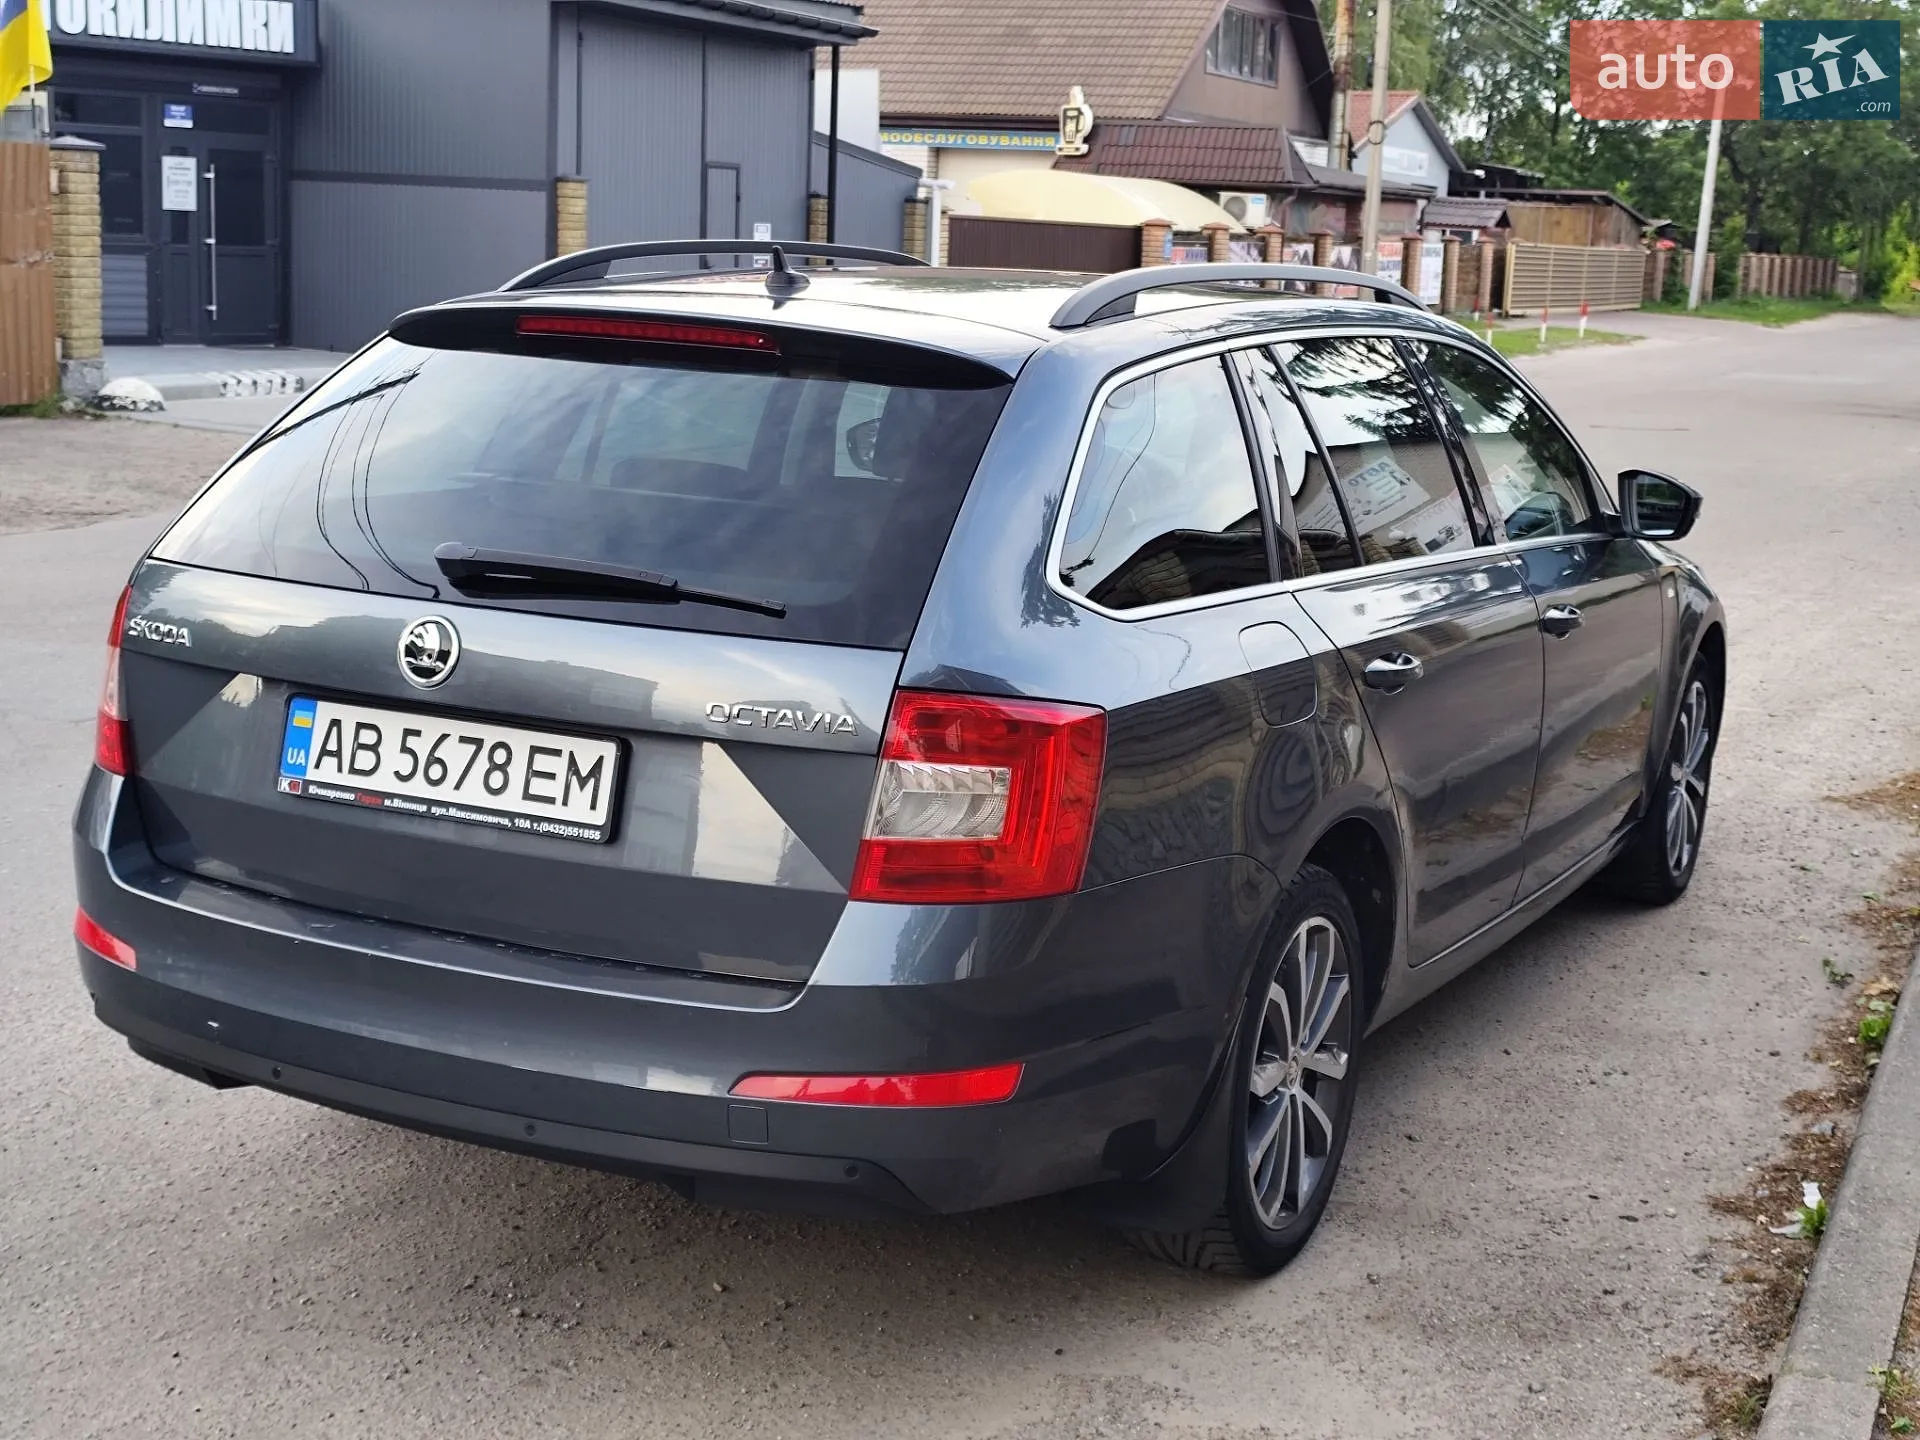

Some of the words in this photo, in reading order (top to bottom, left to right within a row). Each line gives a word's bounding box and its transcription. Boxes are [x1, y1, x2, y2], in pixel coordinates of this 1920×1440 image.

[45, 0, 295, 53] ОКИЛИМКИ
[705, 702, 859, 736] OCTAVIA
[287, 747, 307, 767] UA
[313, 718, 382, 777] AB
[393, 728, 513, 796] 5678
[521, 744, 605, 811] EM
